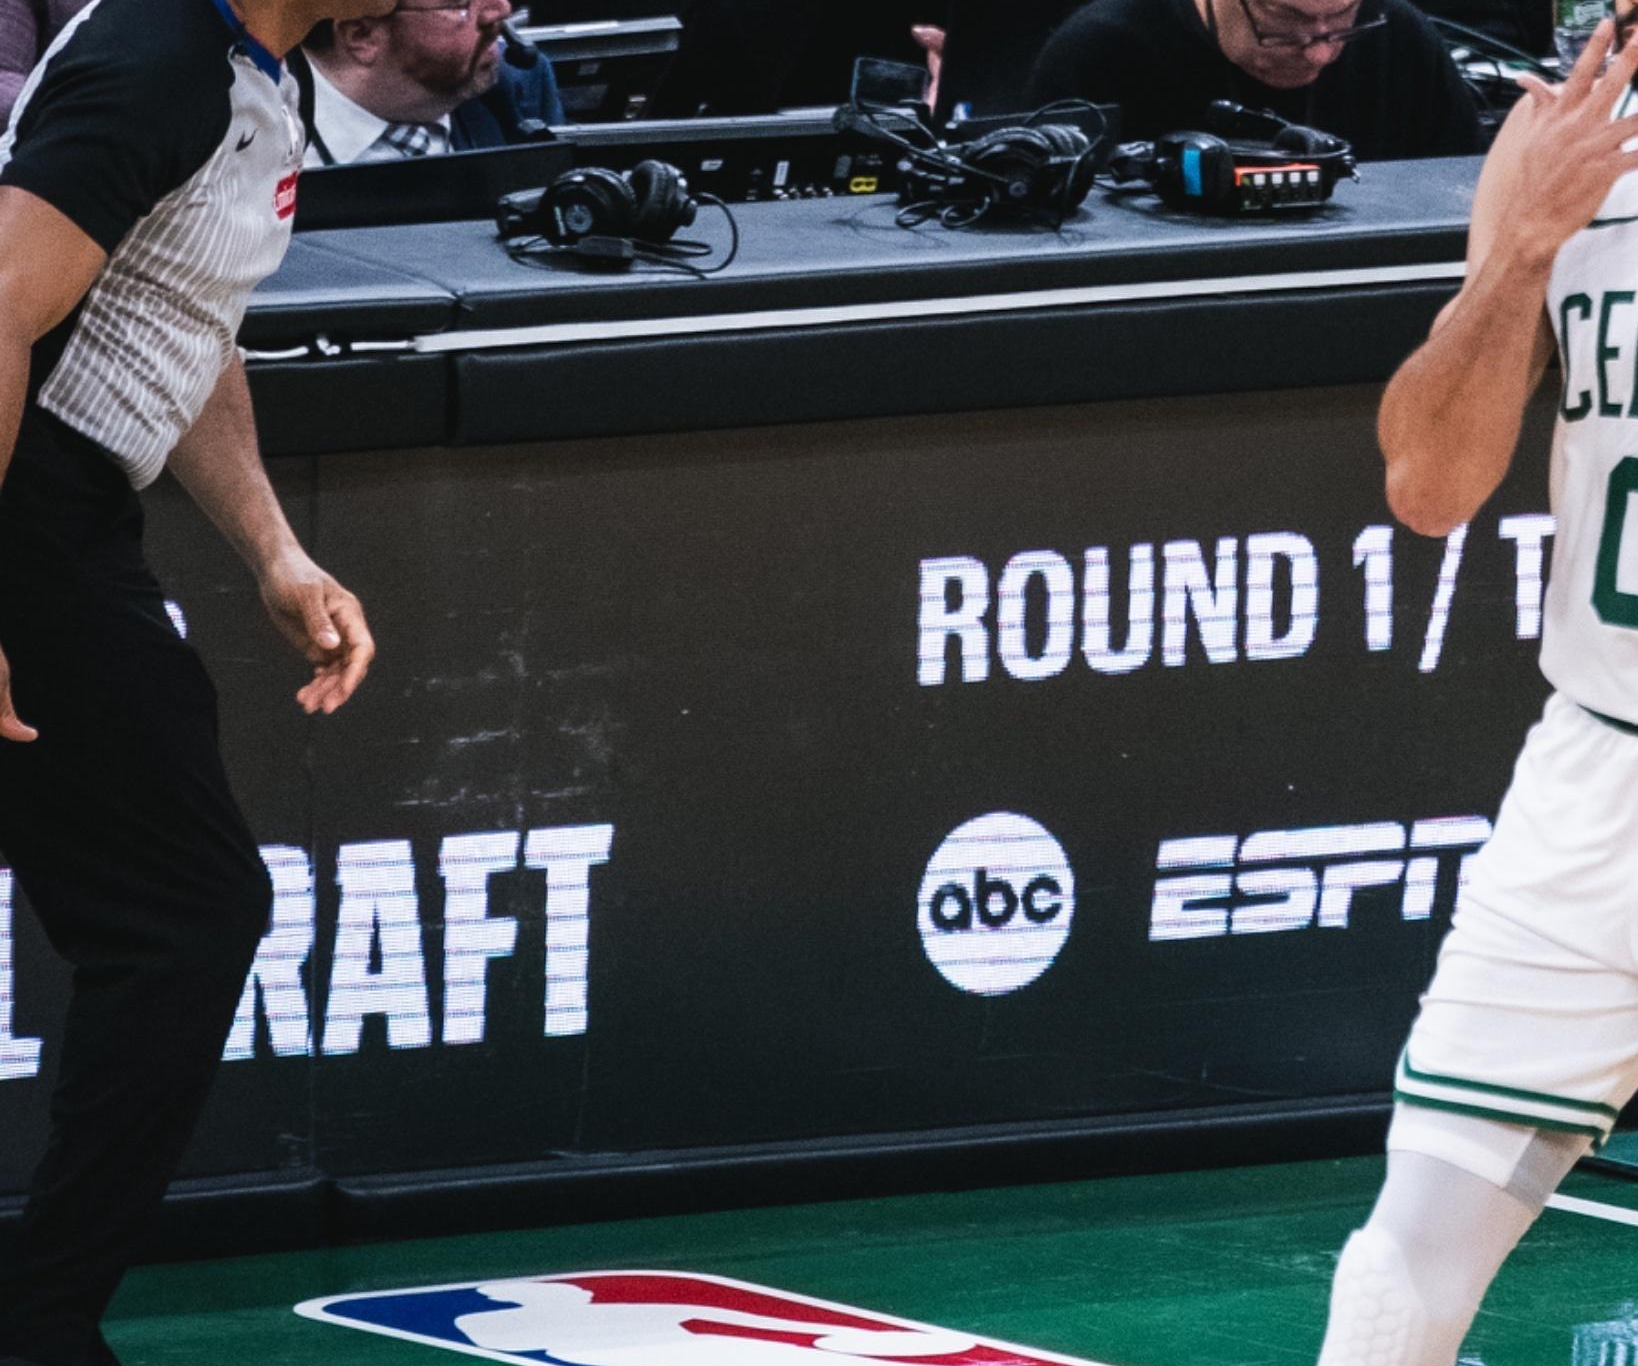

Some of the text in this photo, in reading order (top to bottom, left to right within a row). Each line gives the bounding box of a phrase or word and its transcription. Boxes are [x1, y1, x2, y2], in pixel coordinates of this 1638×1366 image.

[917, 531, 1318, 687] ROUND
[1353, 523, 1394, 651] 1
[222, 823, 615, 1062] RAFT
